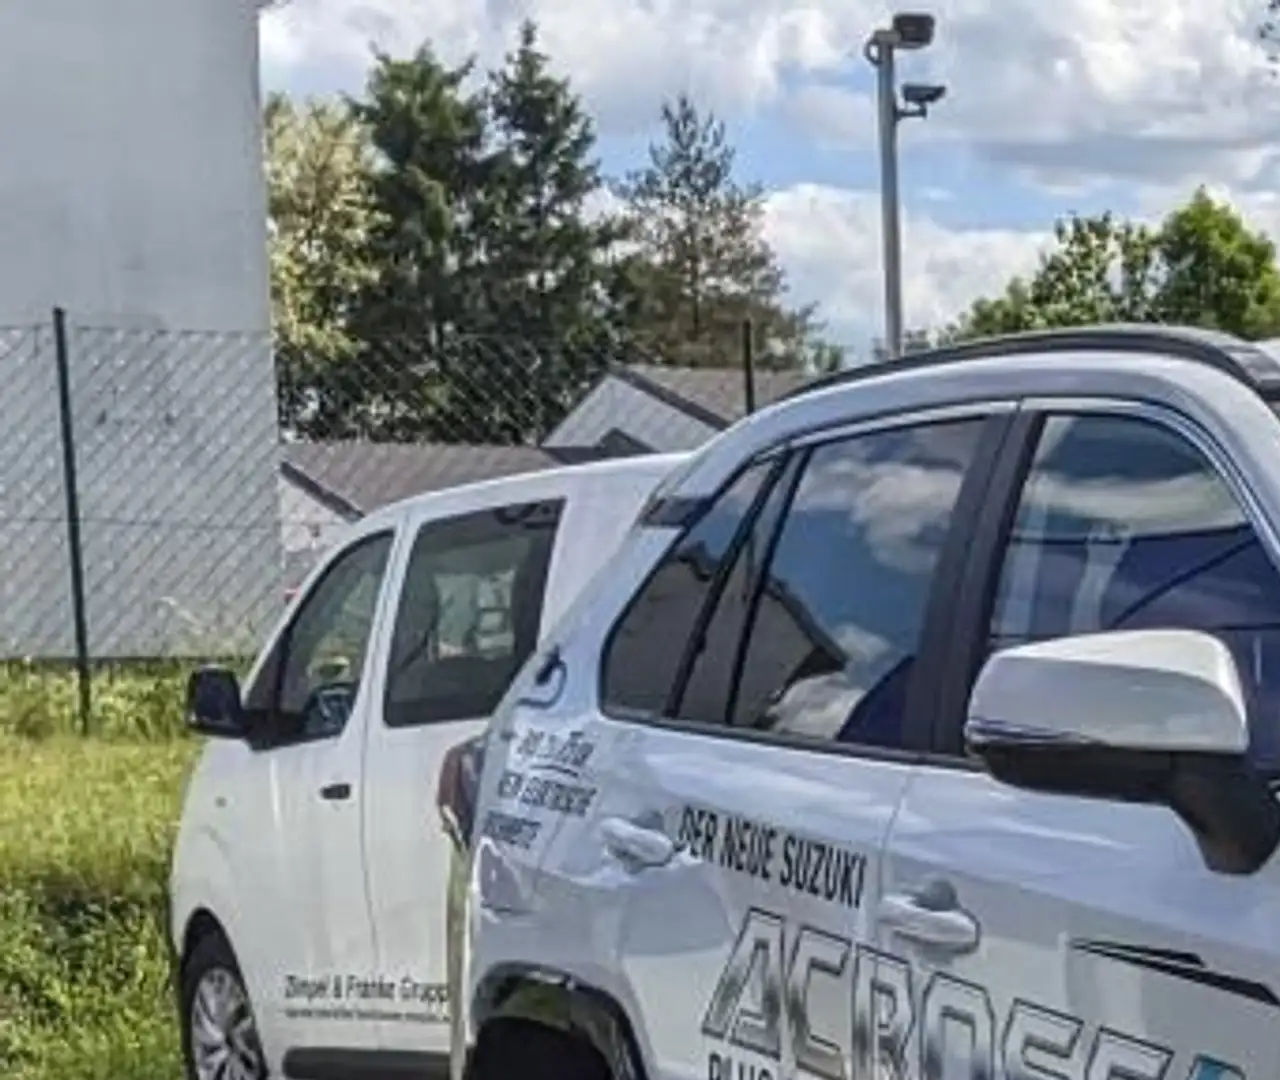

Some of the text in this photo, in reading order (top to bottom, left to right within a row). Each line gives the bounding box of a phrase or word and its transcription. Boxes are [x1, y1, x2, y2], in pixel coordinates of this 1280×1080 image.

[679, 804, 868, 909] DER NEUE SUZUKI
[400, 977, 450, 1006] Grupp
